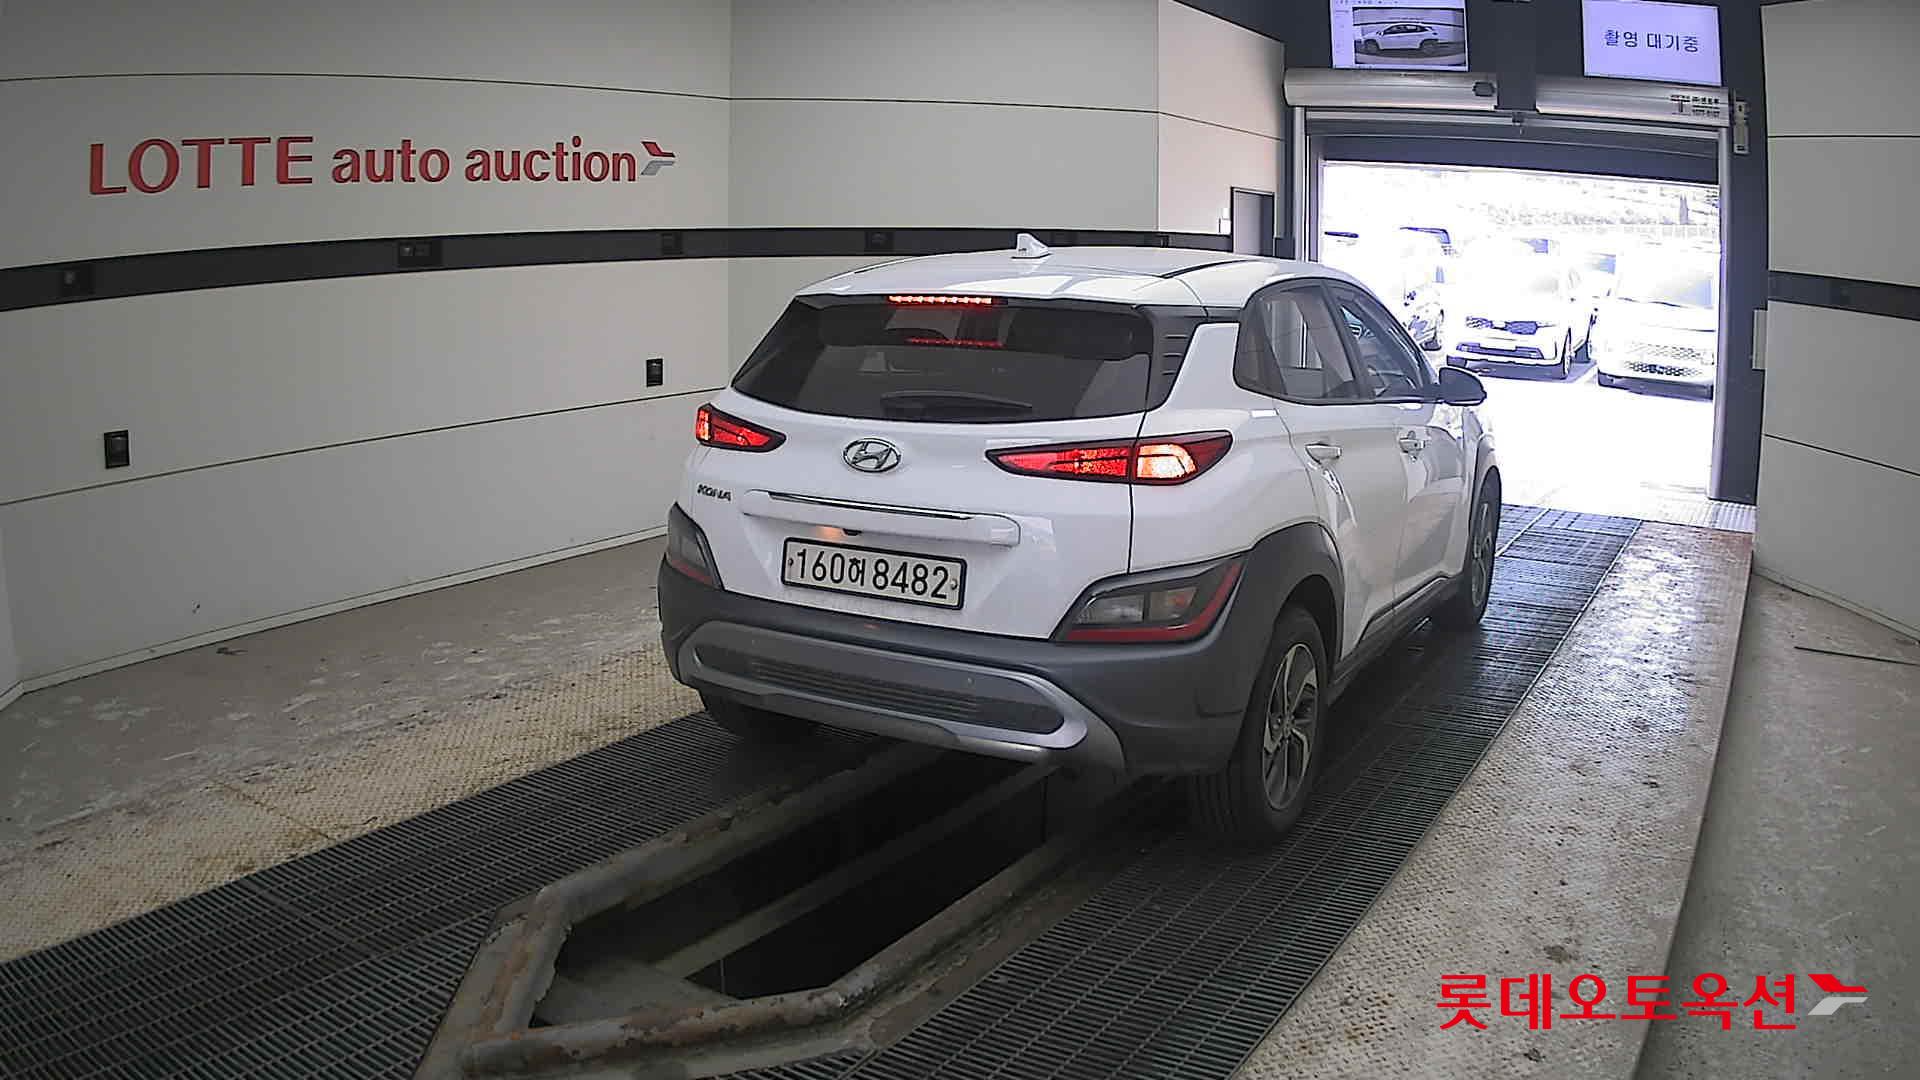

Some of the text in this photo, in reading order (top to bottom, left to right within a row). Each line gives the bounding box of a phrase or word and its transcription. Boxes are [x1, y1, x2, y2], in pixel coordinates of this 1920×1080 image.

[1604, 29, 1699, 53] 촬영 대기중
[88, 135, 637, 195] LOTTE auto auction
[697, 483, 732, 502] KONA
